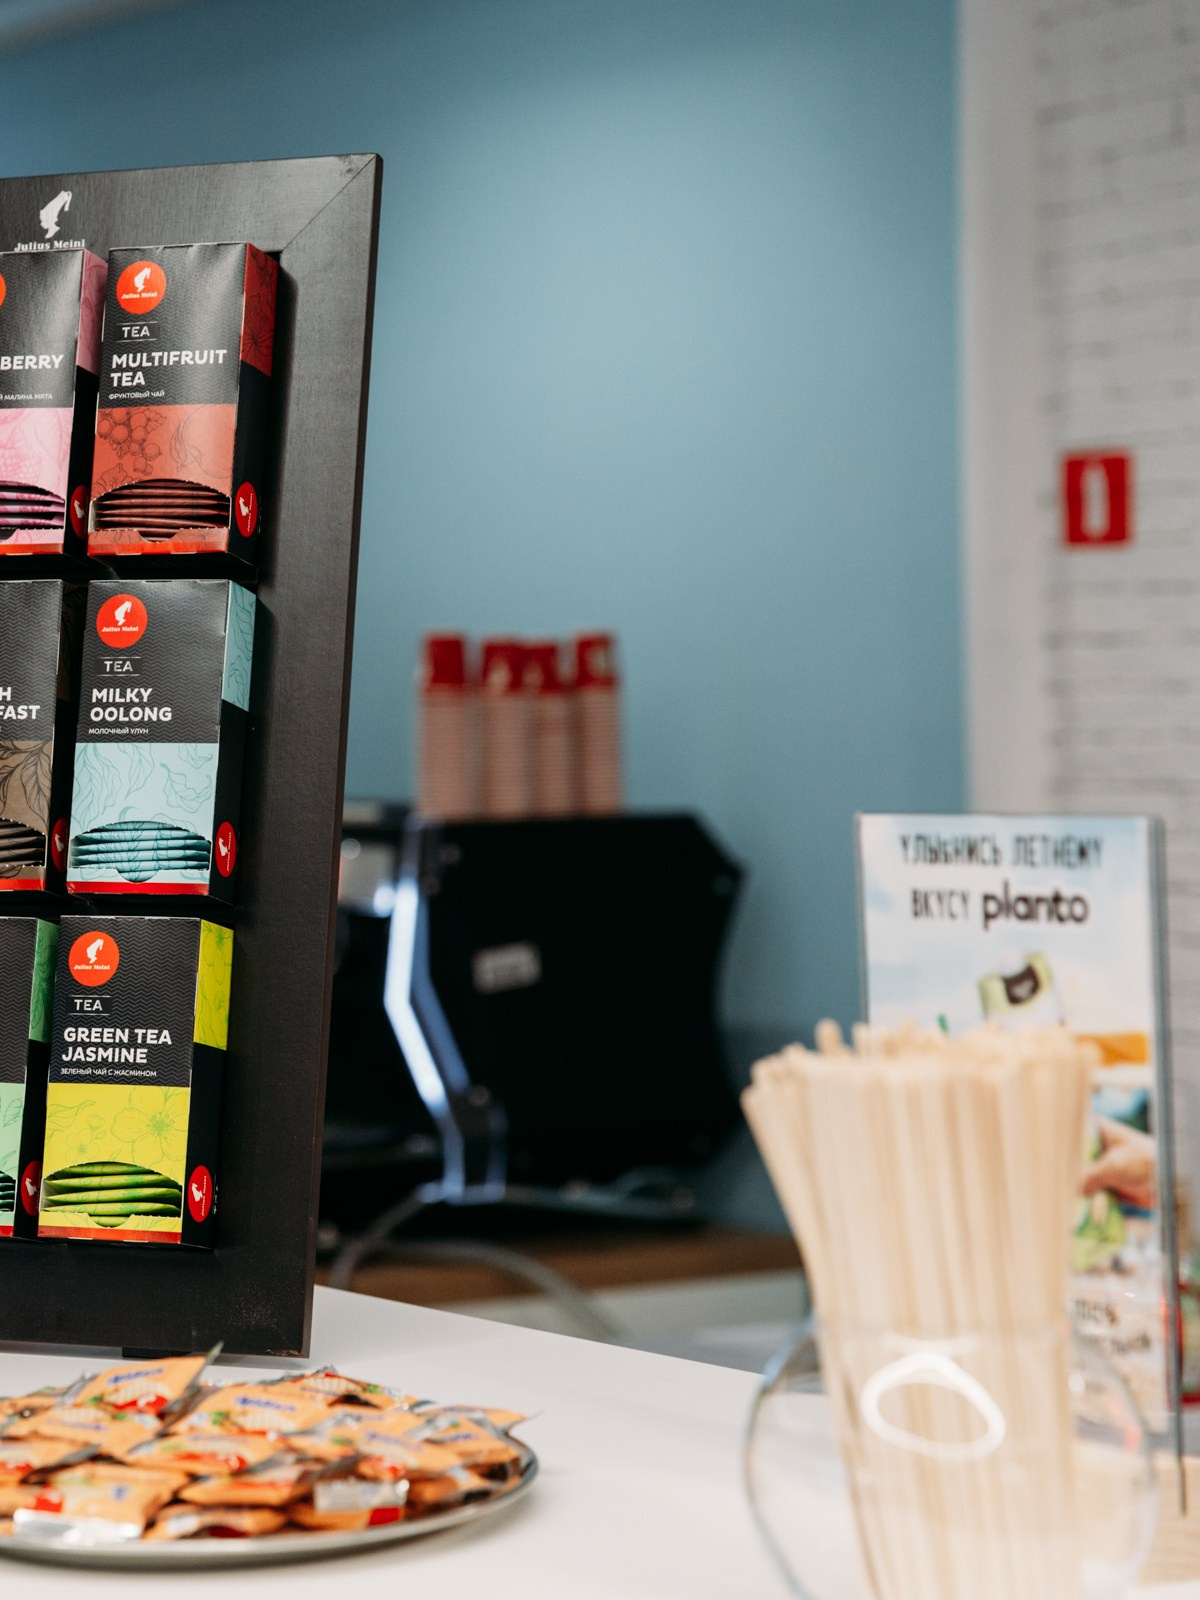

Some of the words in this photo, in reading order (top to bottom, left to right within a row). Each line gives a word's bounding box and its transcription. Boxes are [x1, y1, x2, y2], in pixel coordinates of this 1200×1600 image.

[14, 242, 50, 251] Julius
[54, 239, 85, 249] Meinl
[122, 326, 150, 338] TEA
[112, 349, 227, 369] MULTIFRUIT
[111, 371, 145, 387] TEA
[108, 391, 150, 400] ФРУКТОВЫЙ
[104, 661, 133, 672] TEA
[92, 688, 153, 703] MILKY
[90, 707, 172, 722] OOLONG
[88, 727, 129, 735] МОЛОЧНЫЙ
[898, 833, 1003, 868] УЛЫБНИСЬ
[1010, 835, 1104, 869] ЛЕТНЕМУ
[911, 888, 970, 919] ВКУСУ
[982, 880, 1089, 932] planto
[74, 1000, 103, 1011] TEA
[63, 1027, 129, 1043] GREEN
[134, 1028, 172, 1045] TEA
[62, 1047, 148, 1064] JASMINE
[61, 1067, 92, 1075] ЗЕЛЕНЫЙ
[93, 1067, 107, 1075] ЧАЙ
[114, 1069, 157, 1077] ЖАСМИНОМ
